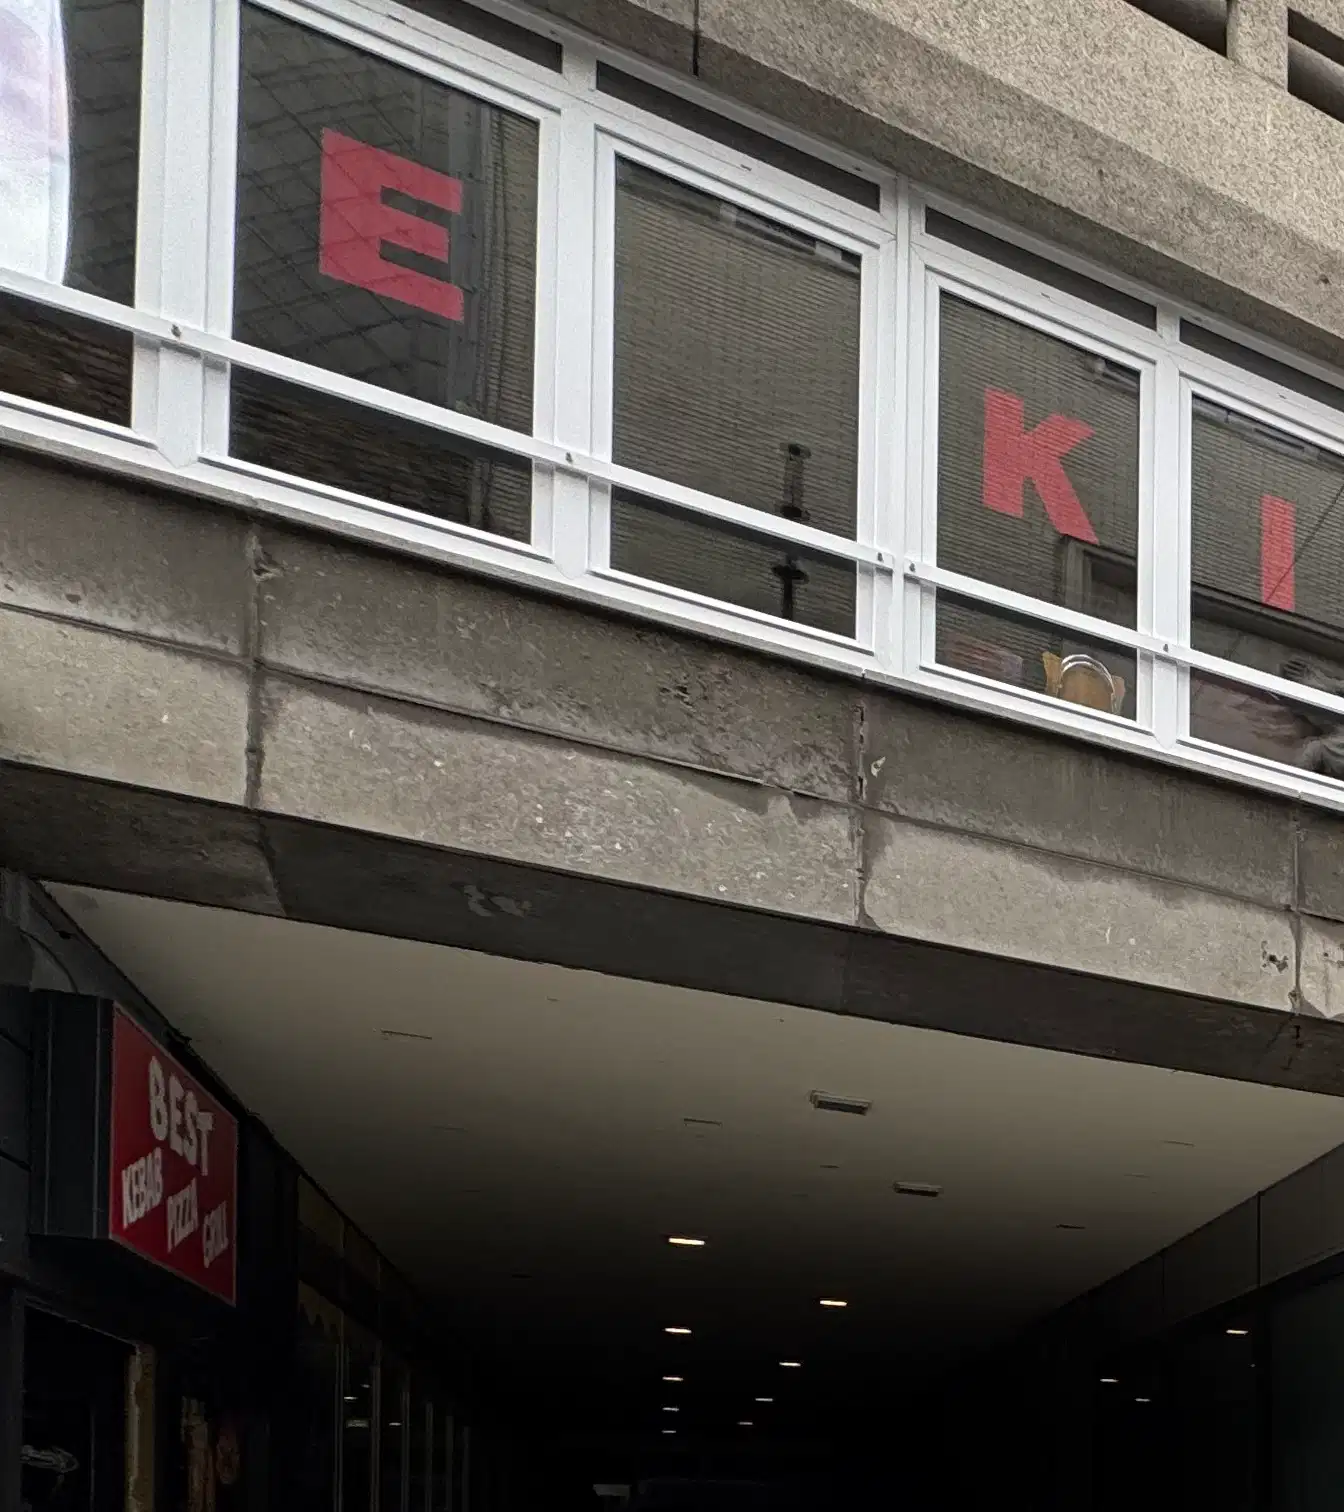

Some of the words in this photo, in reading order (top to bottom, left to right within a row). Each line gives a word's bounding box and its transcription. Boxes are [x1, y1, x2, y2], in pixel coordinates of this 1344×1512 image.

[320, 129, 464, 322] E
[148, 1055, 215, 1177] BEST
[121, 1146, 163, 1231] KEBAB
[165, 1177, 200, 1254] PIZZA
